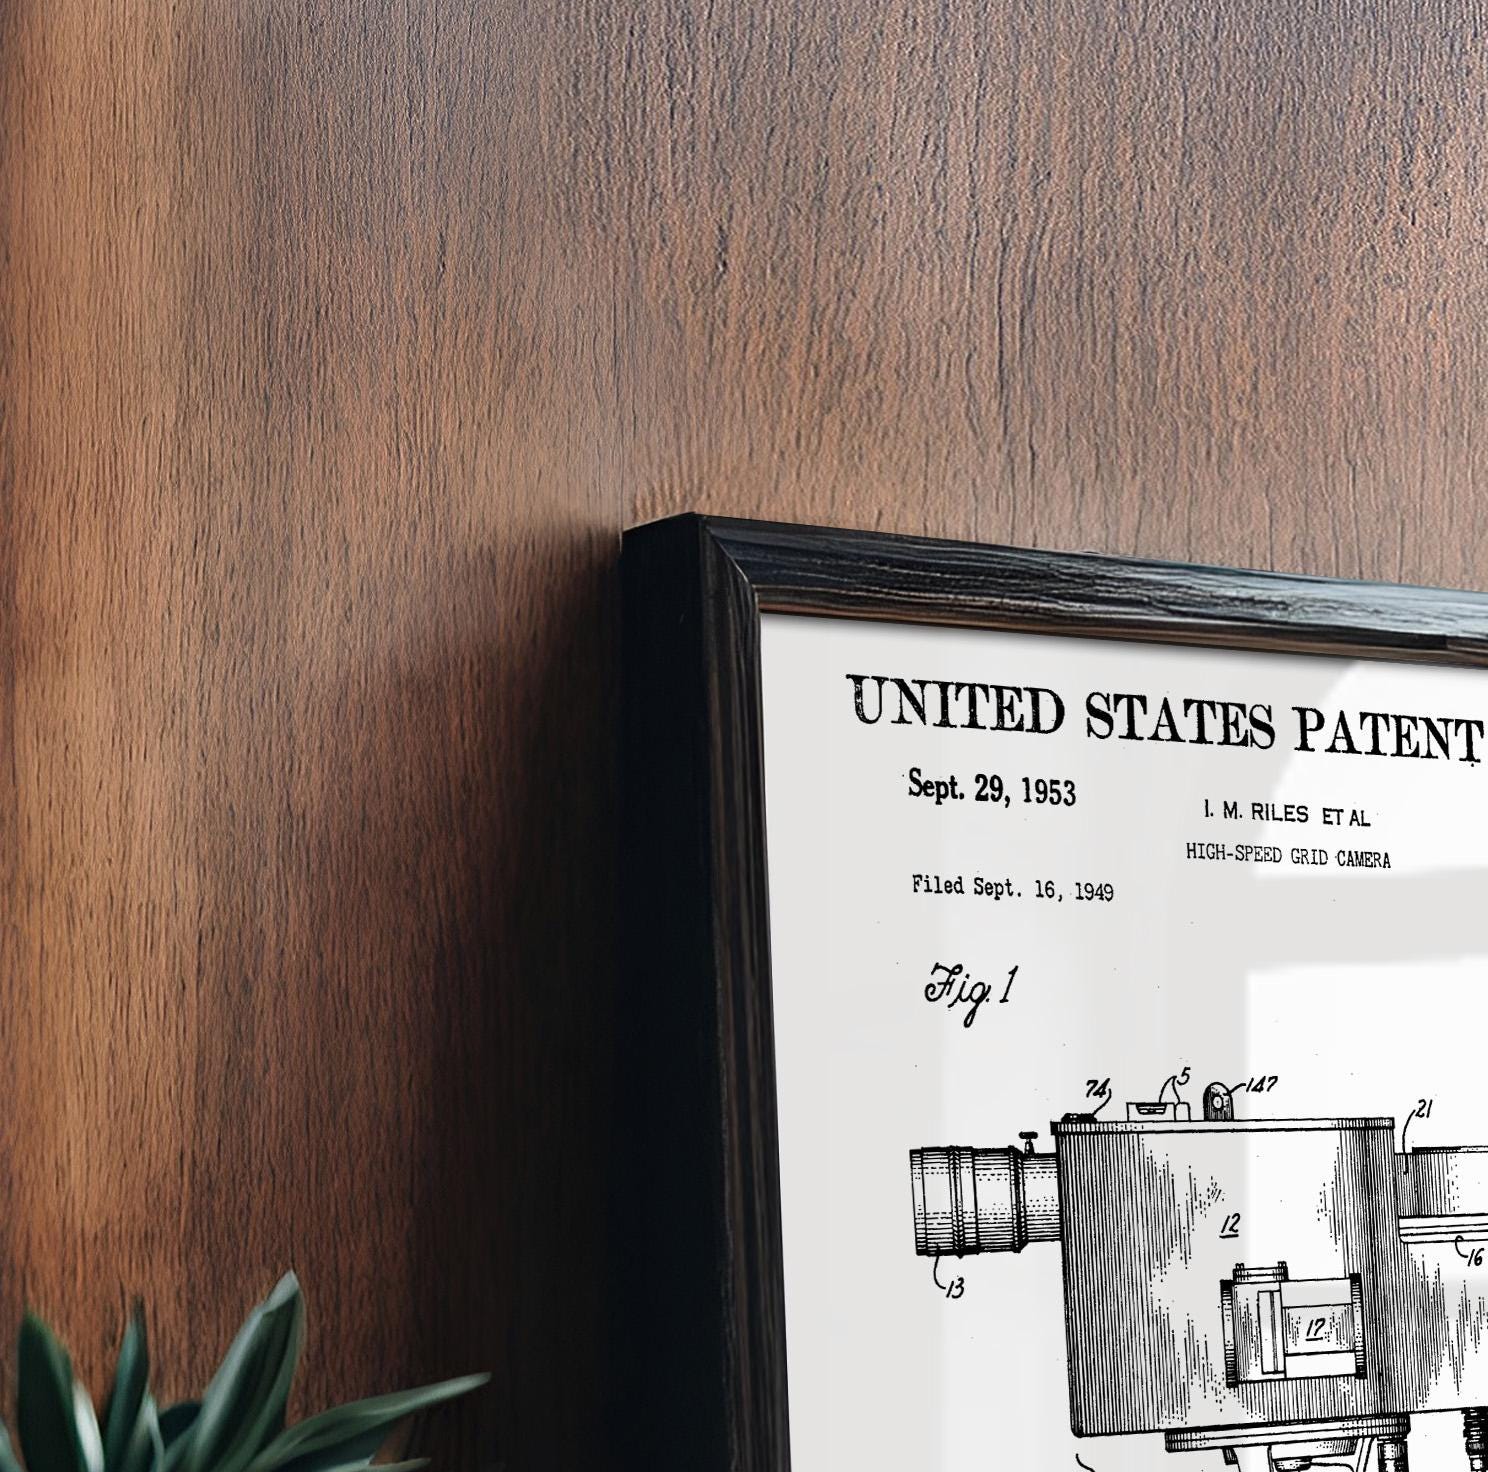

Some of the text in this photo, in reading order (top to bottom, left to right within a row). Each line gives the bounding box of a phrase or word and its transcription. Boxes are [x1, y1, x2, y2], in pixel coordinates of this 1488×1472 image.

[846, 673, 1065, 735] UNITED
[1086, 692, 1275, 750] STATES
[1293, 705, 1484, 765] PATENT
[908, 767, 1077, 809] Sept. 29, 1953
[1204, 799, 1371, 827] I. M. RILES ET AL
[1186, 842, 1391, 869] HIGH-SPEED GRID CAMERA
[912, 874, 1114, 902] Filed Sept. 16, 1949
[924, 962, 1019, 1028] Fig. 1
[1176, 1067, 1191, 1085] 5
[1245, 1076, 1278, 1093] 147
[1085, 1078, 1110, 1098] 74
[1415, 1099, 1433, 1118] 21
[1220, 1212, 1241, 1234] 12
[1467, 1248, 1485, 1267] 16
[945, 1278, 965, 1299] 13
[1305, 1317, 1326, 1337] 17
